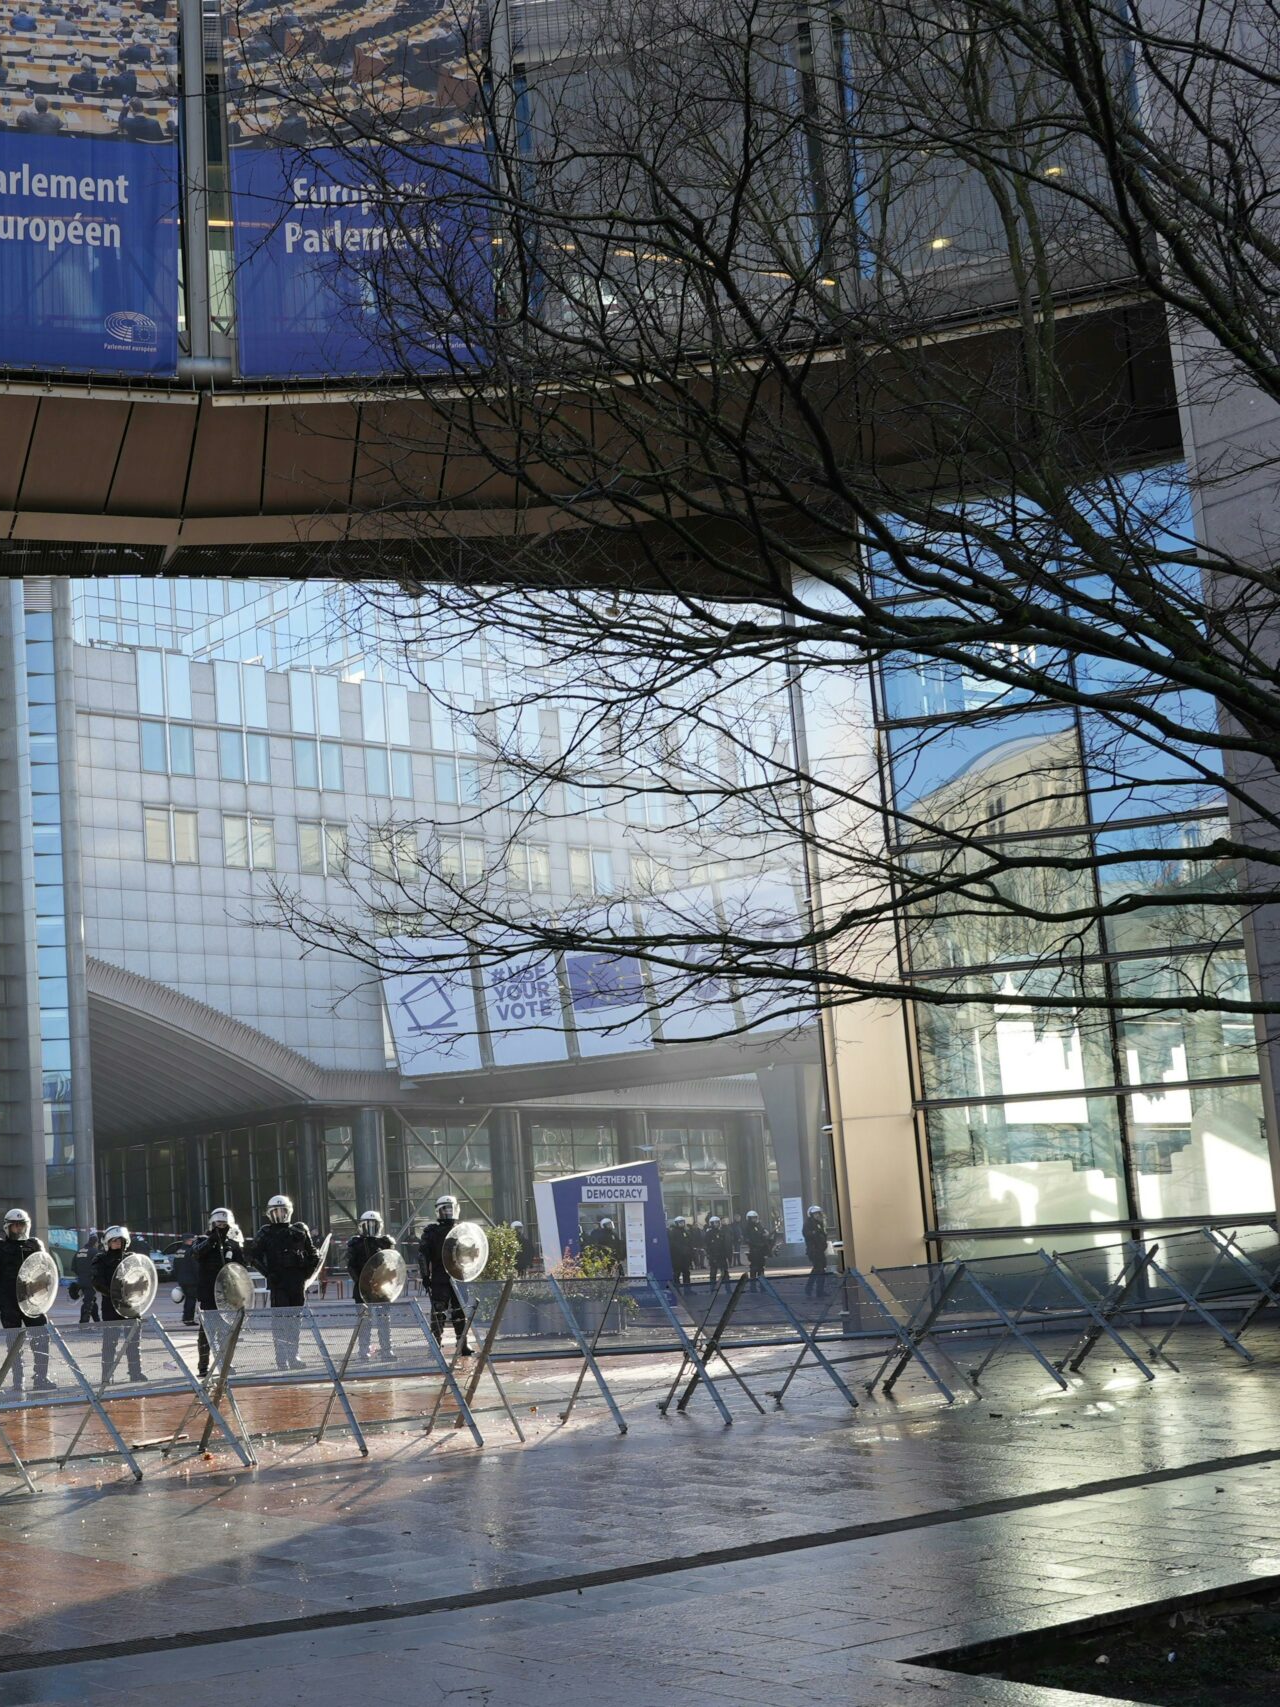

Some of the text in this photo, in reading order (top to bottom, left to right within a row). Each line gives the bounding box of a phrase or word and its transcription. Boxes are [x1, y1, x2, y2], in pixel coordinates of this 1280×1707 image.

[104, 343, 131, 351] Parlement
[494, 981, 551, 1002] YOUR
[496, 1000, 553, 1021] VOTE
[586, 1175, 643, 1185] TOGETHER FOR
[586, 1188, 643, 1200] DEMOCRACY
